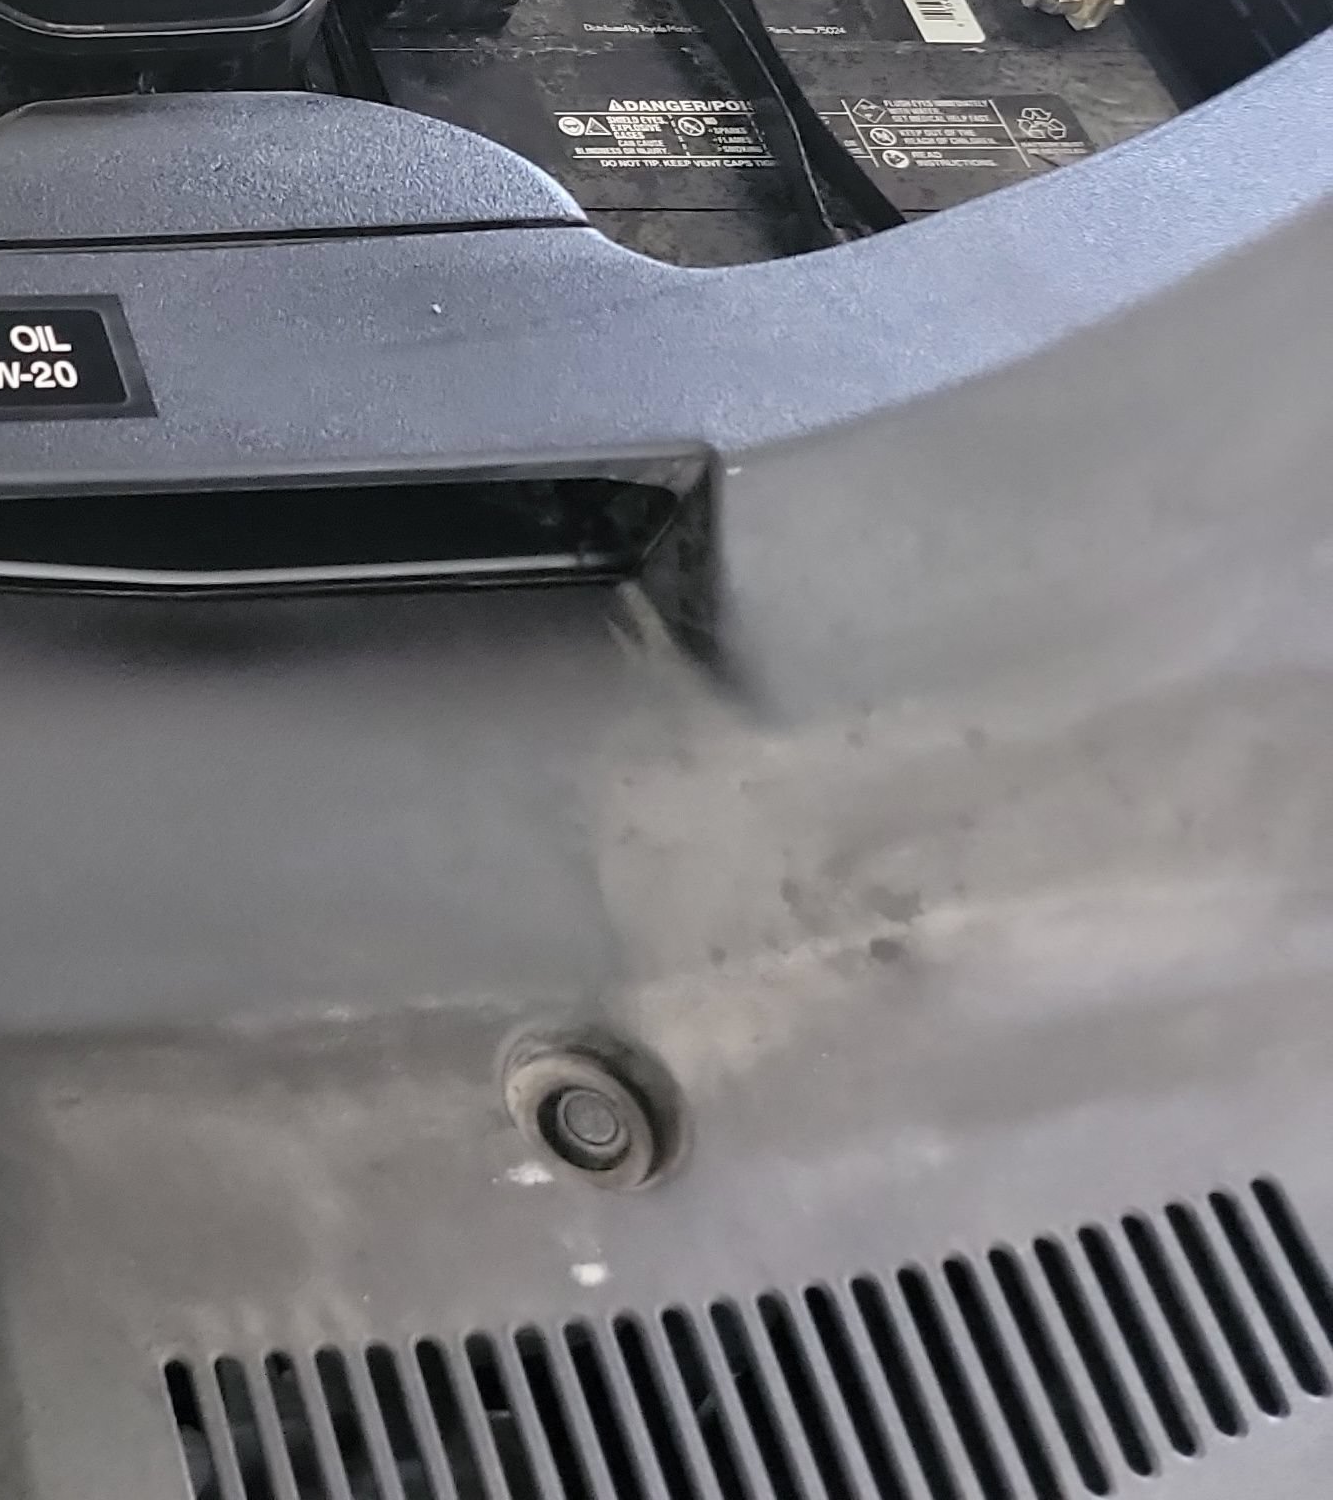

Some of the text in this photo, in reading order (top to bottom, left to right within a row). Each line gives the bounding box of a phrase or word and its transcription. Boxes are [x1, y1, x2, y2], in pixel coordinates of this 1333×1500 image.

[640, 24, 667, 34] Toyota
[605, 116, 639, 125] SHIELD
[609, 124, 663, 133] EXPLOSIVE
[613, 131, 646, 140] GASES
[617, 140, 666, 148] CAN CAUSE
[600, 159, 618, 168] DO
[619, 159, 641, 168] NOT
[662, 159, 692, 168] KEEP
[693, 159, 724, 168] VENT
[723, 159, 755, 168] CAPS
[9, 325, 72, 353] OIL
